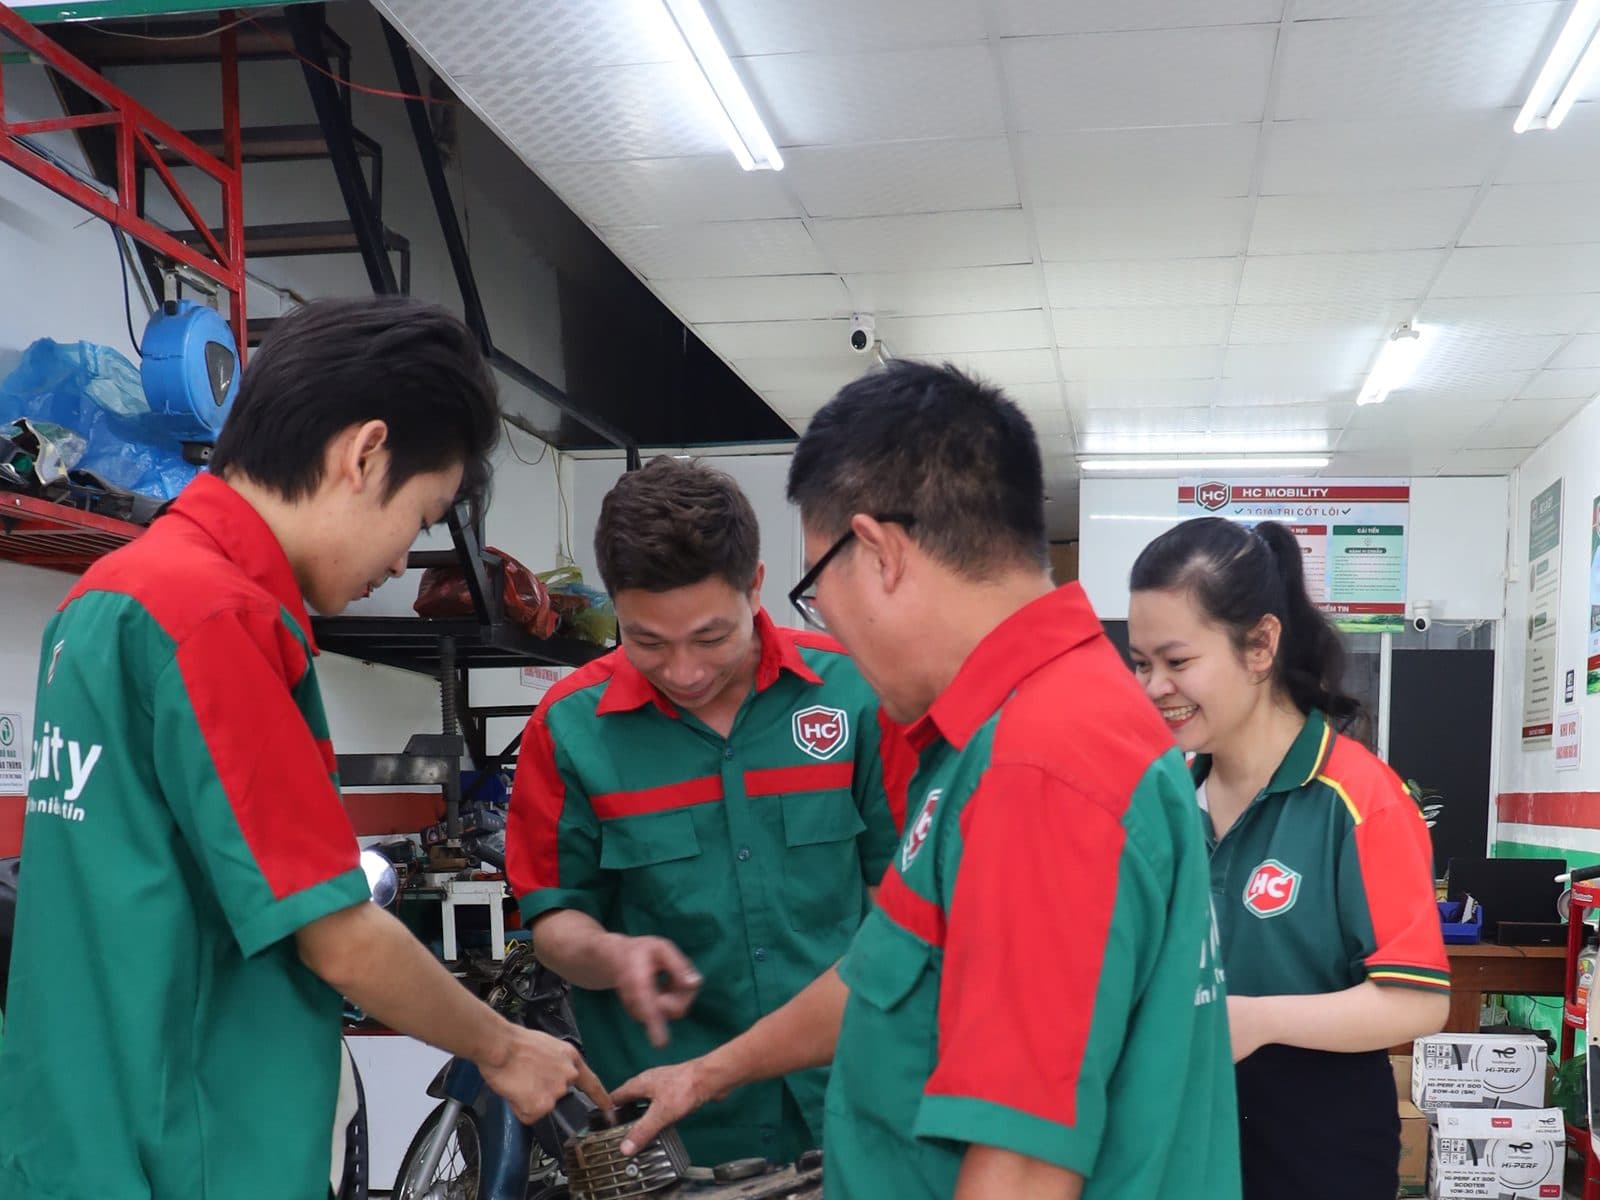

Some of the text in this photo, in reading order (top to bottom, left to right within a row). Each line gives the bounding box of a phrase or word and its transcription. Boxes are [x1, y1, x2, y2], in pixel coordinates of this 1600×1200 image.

[1202, 489, 1226, 502] HC
[1242, 487, 1329, 498] HC MOBILITY
[804, 723, 838, 740] HC
[1250, 873, 1289, 899] HC
